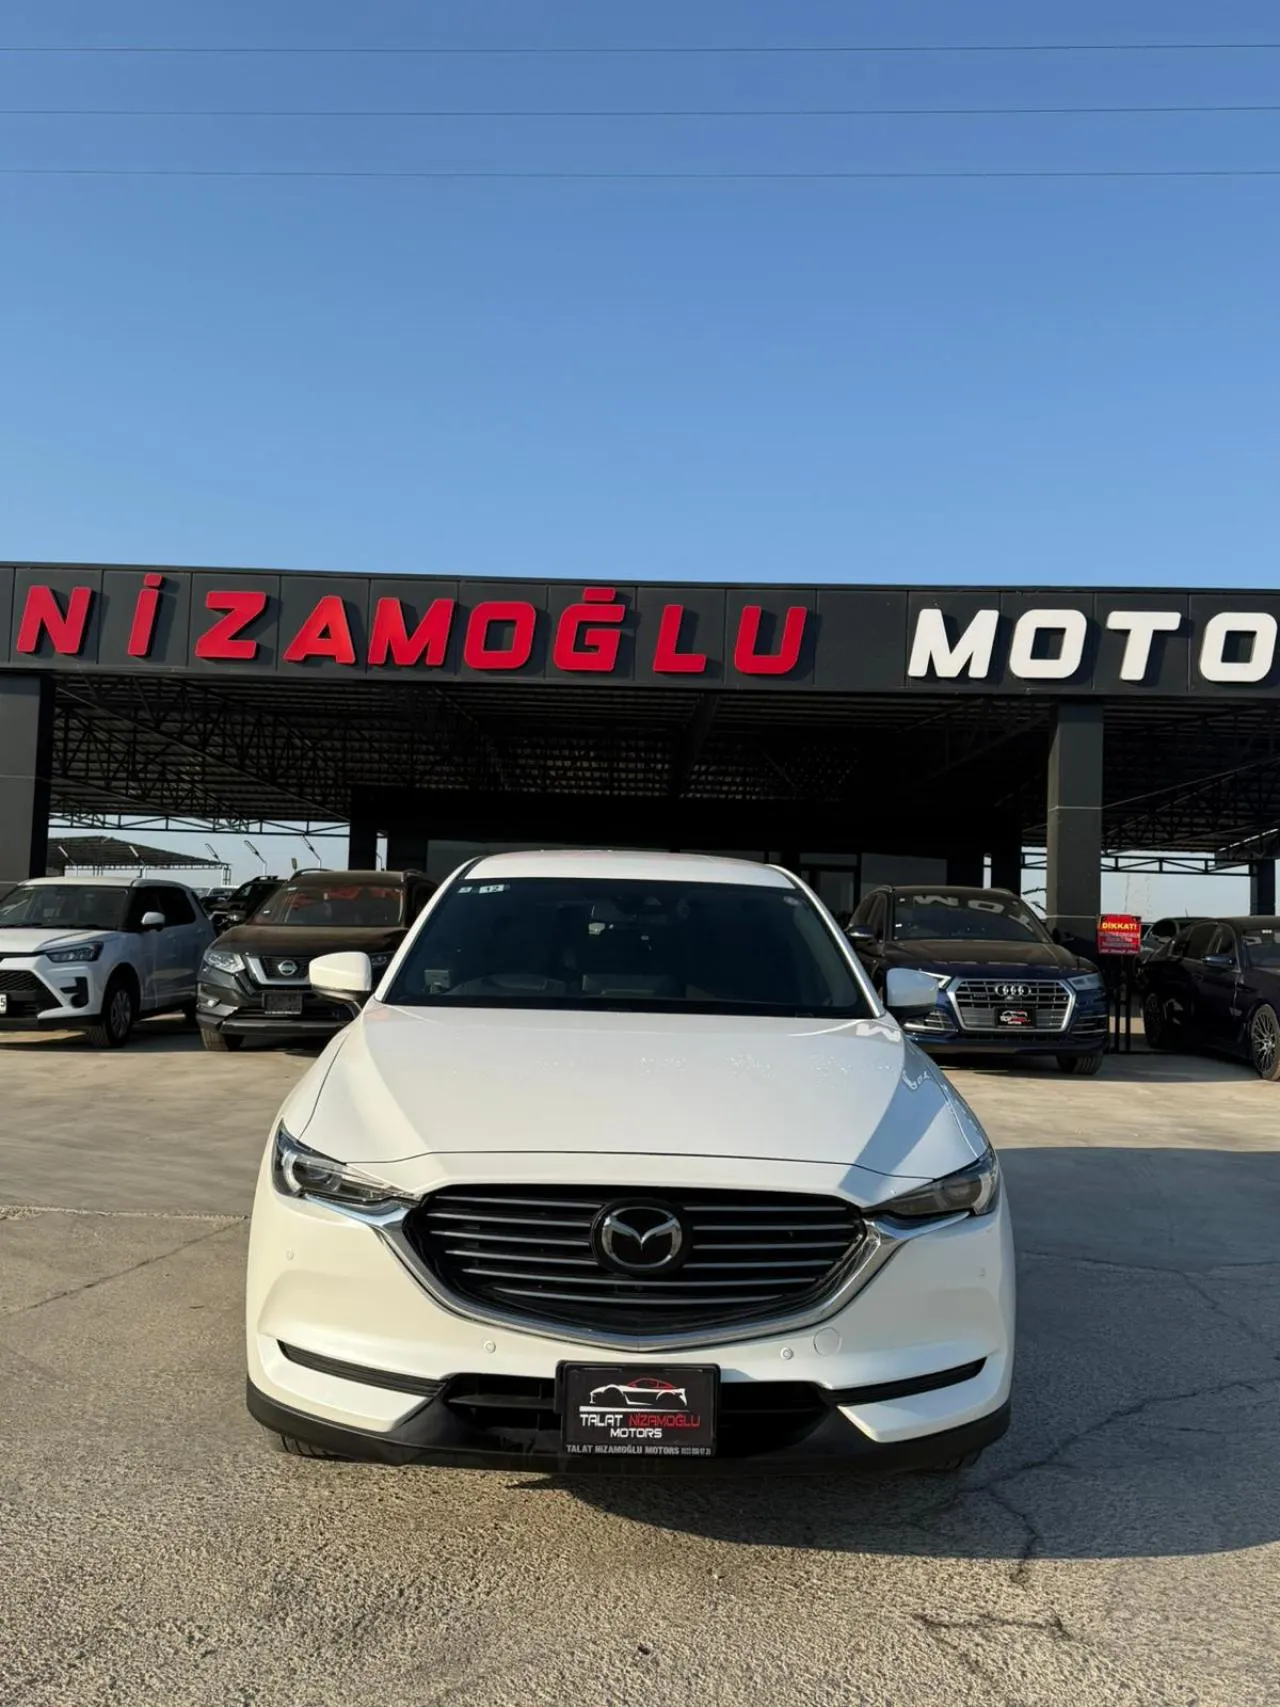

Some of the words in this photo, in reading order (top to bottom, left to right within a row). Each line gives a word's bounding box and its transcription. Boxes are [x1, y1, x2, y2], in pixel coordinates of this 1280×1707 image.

[16, 573, 808, 676] NİZAMOĞLU
[907, 608, 1278, 682] MOTO
[580, 1414, 623, 1427] TALAT
[610, 1428, 663, 1438] MOTORS
[566, 1444, 593, 1454] TALAT
[645, 1445, 680, 1455] MOTORS
